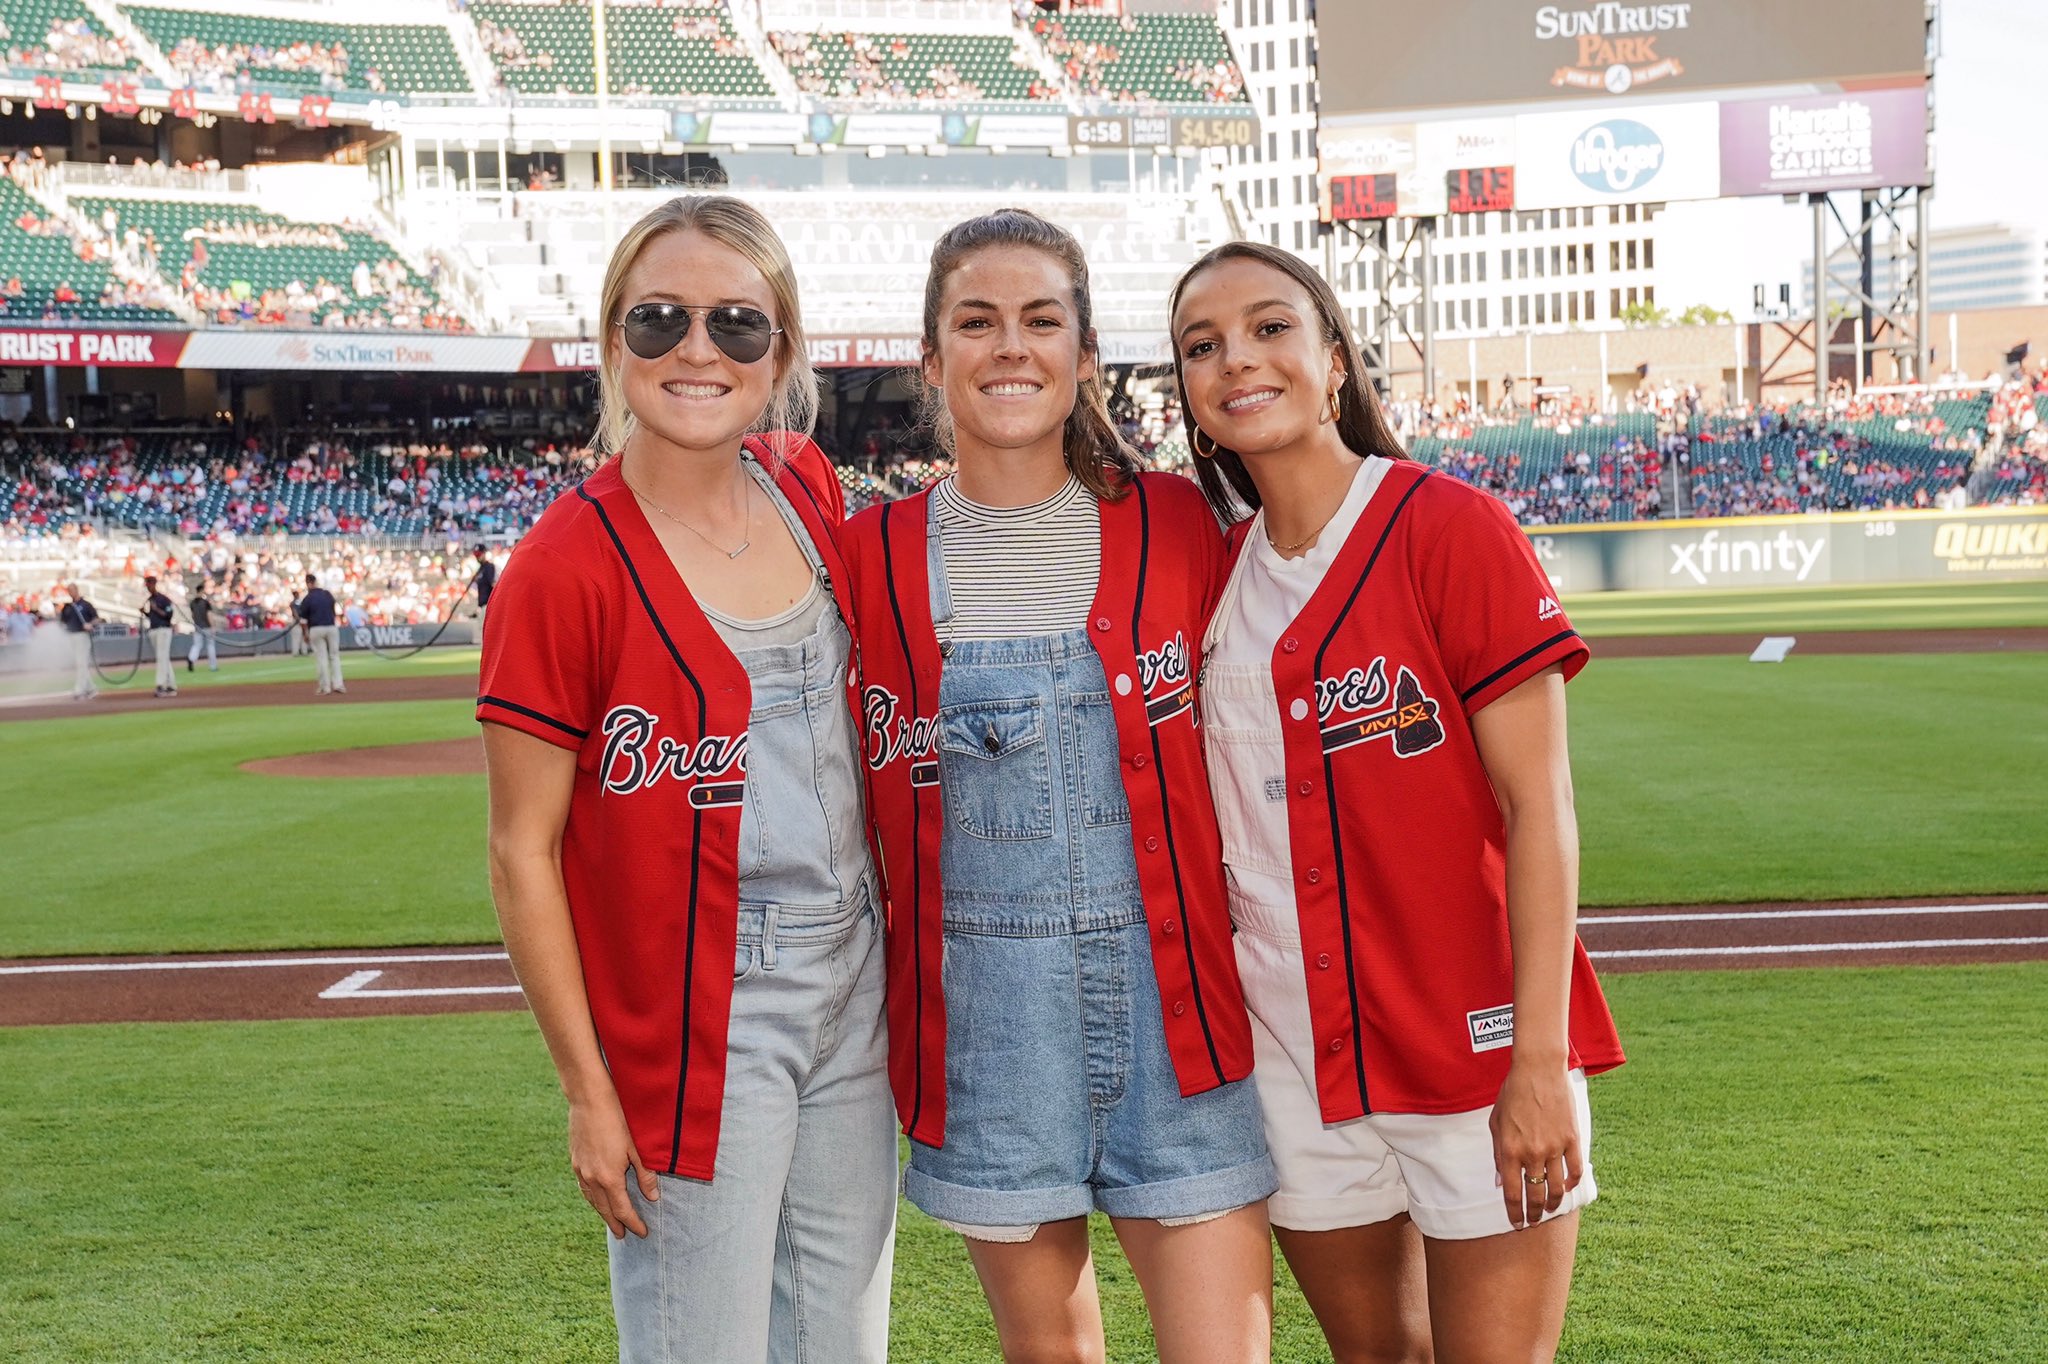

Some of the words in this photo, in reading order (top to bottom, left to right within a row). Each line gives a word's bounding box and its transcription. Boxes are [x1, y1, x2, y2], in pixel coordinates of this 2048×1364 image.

[1575, 35, 1659, 67] PARK
[239, 91, 276, 123] 44
[299, 95, 332, 127] 47
[367, 99, 400, 131] 42
[1077, 120, 1123, 143] 6:58
[1180, 118, 1250, 146] $4,540
[1574, 126, 1662, 191] Kroger
[1770, 148, 1872, 171] CASINOS
[79, 334, 154, 362] PARK
[1670, 530, 1825, 584] xfinity
[373, 626, 413, 646] WISE
